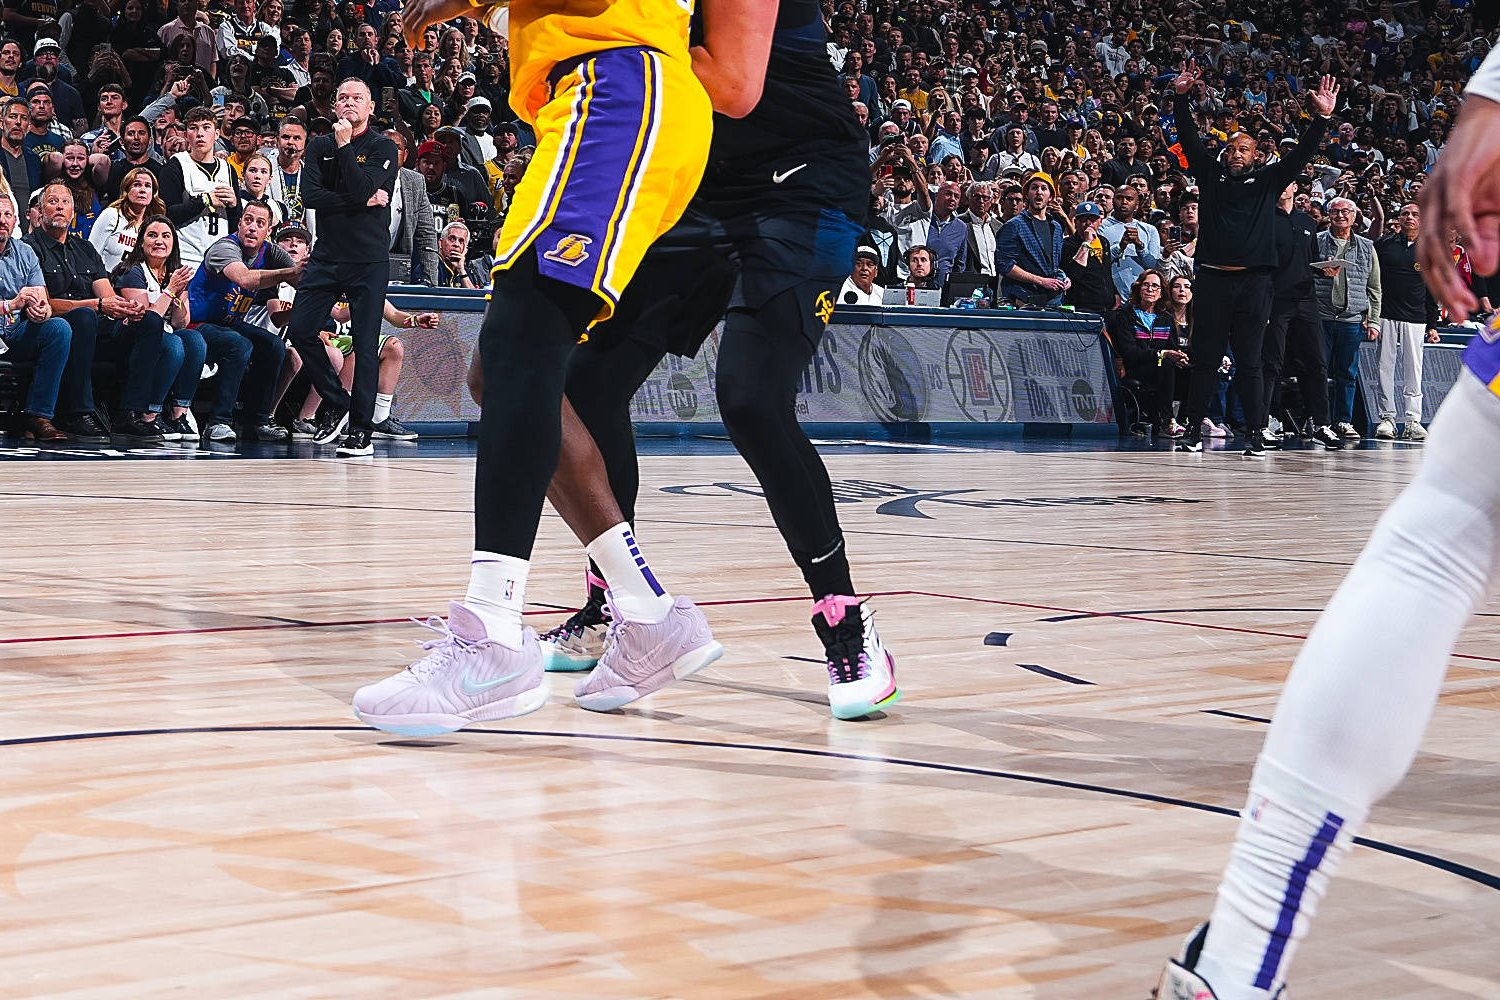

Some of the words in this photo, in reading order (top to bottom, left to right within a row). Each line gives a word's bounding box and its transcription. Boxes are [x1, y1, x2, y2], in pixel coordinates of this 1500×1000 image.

[207, 212, 220, 236] 8
[228, 296, 253, 314] 50
[927, 363, 943, 391] VS
[1071, 394, 1099, 413] TNT
